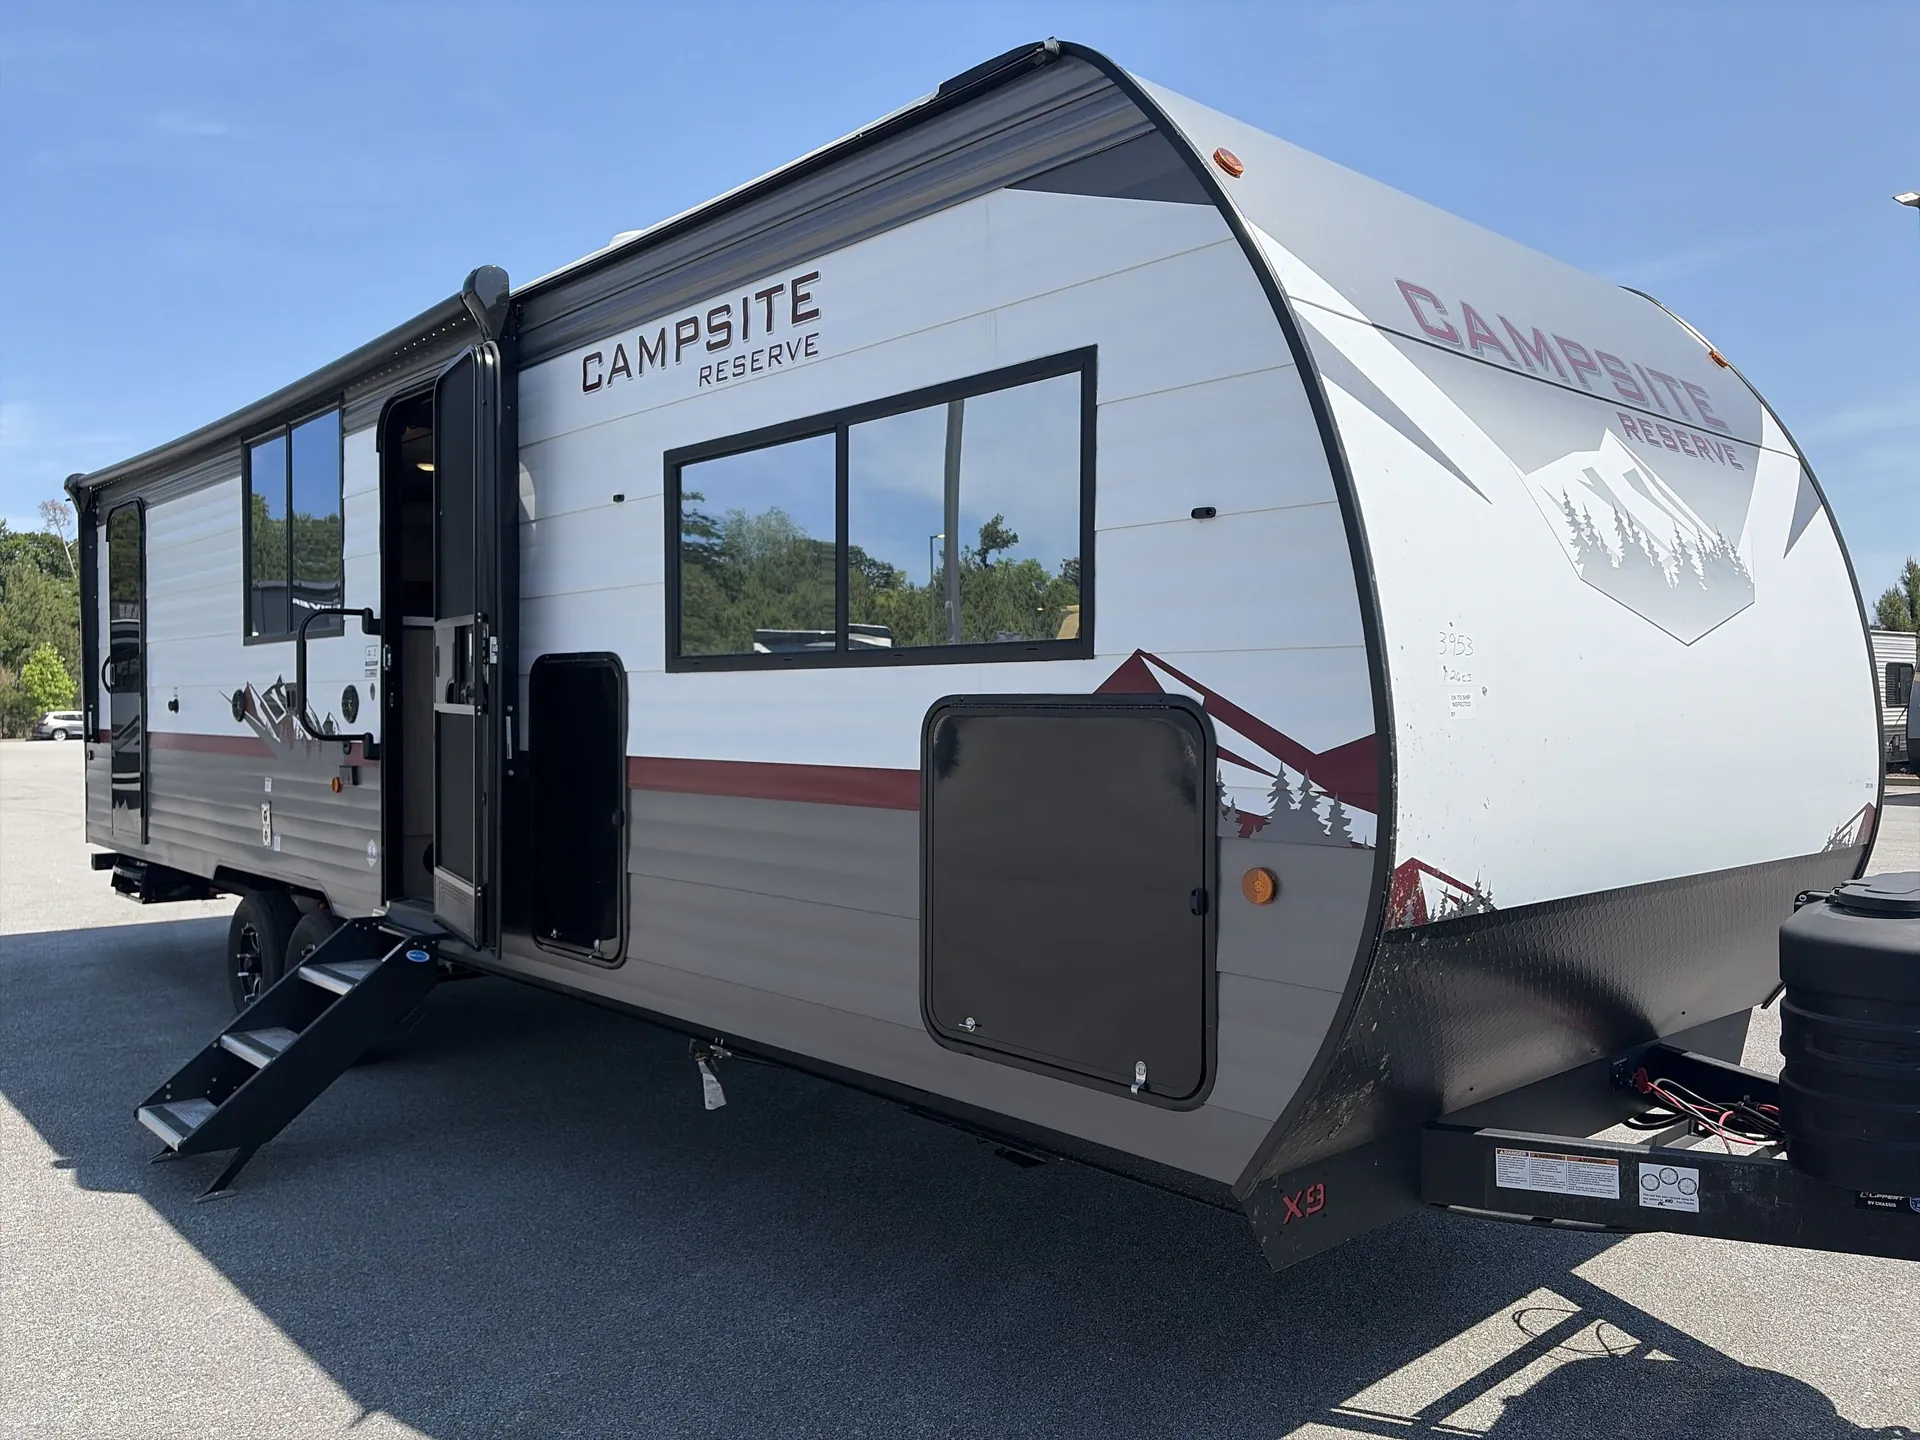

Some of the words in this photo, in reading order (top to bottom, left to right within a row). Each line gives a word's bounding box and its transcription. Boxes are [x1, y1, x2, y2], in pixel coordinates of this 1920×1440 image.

[582, 270, 821, 394] CAMPSITE
[699, 332, 820, 388] RESERVE
[1395, 277, 1732, 435] CAMPSITE
[1616, 411, 1744, 471] RESERVE
[1439, 631, 1475, 656] 3953
[1282, 1183, 1326, 1225] X9
